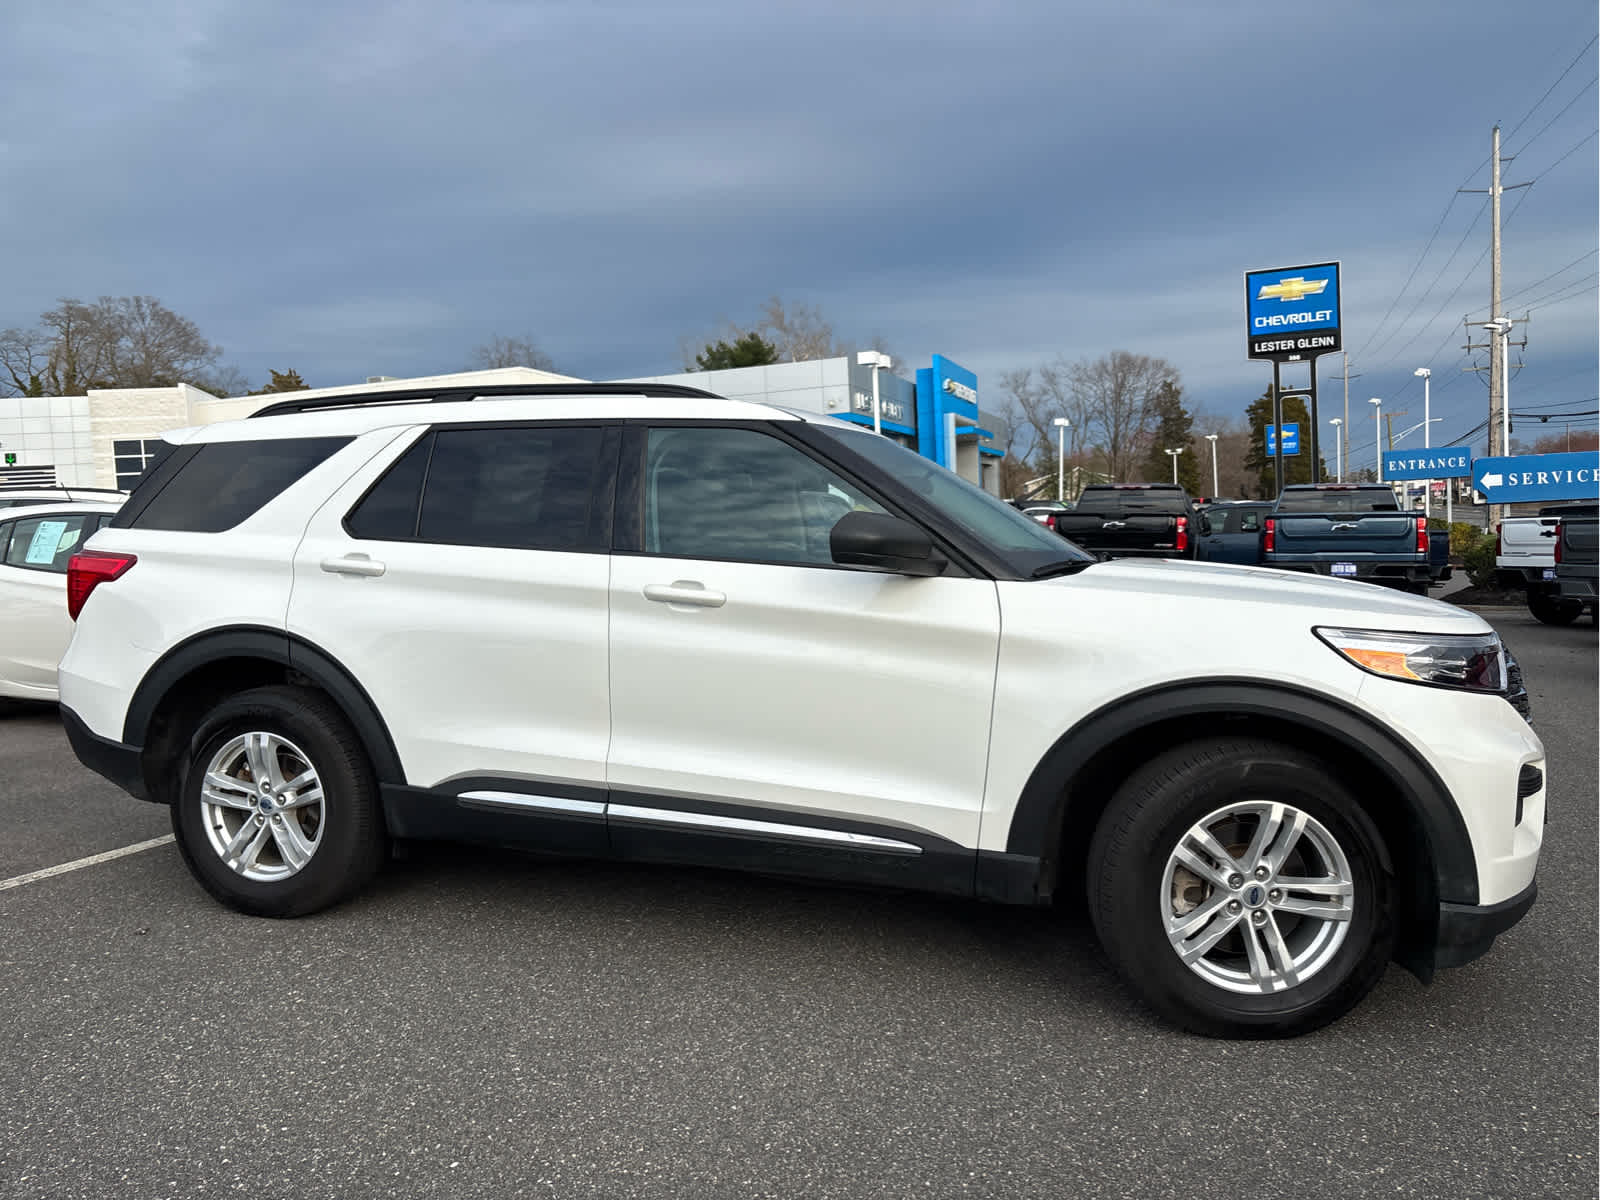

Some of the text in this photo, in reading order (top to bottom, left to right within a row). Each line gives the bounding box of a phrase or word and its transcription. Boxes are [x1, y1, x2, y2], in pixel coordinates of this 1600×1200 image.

[1254, 310, 1333, 328] CHEVROLET
[1254, 336, 1335, 353] LESTER GLENN
[1388, 456, 1467, 472] ENTRANCE
